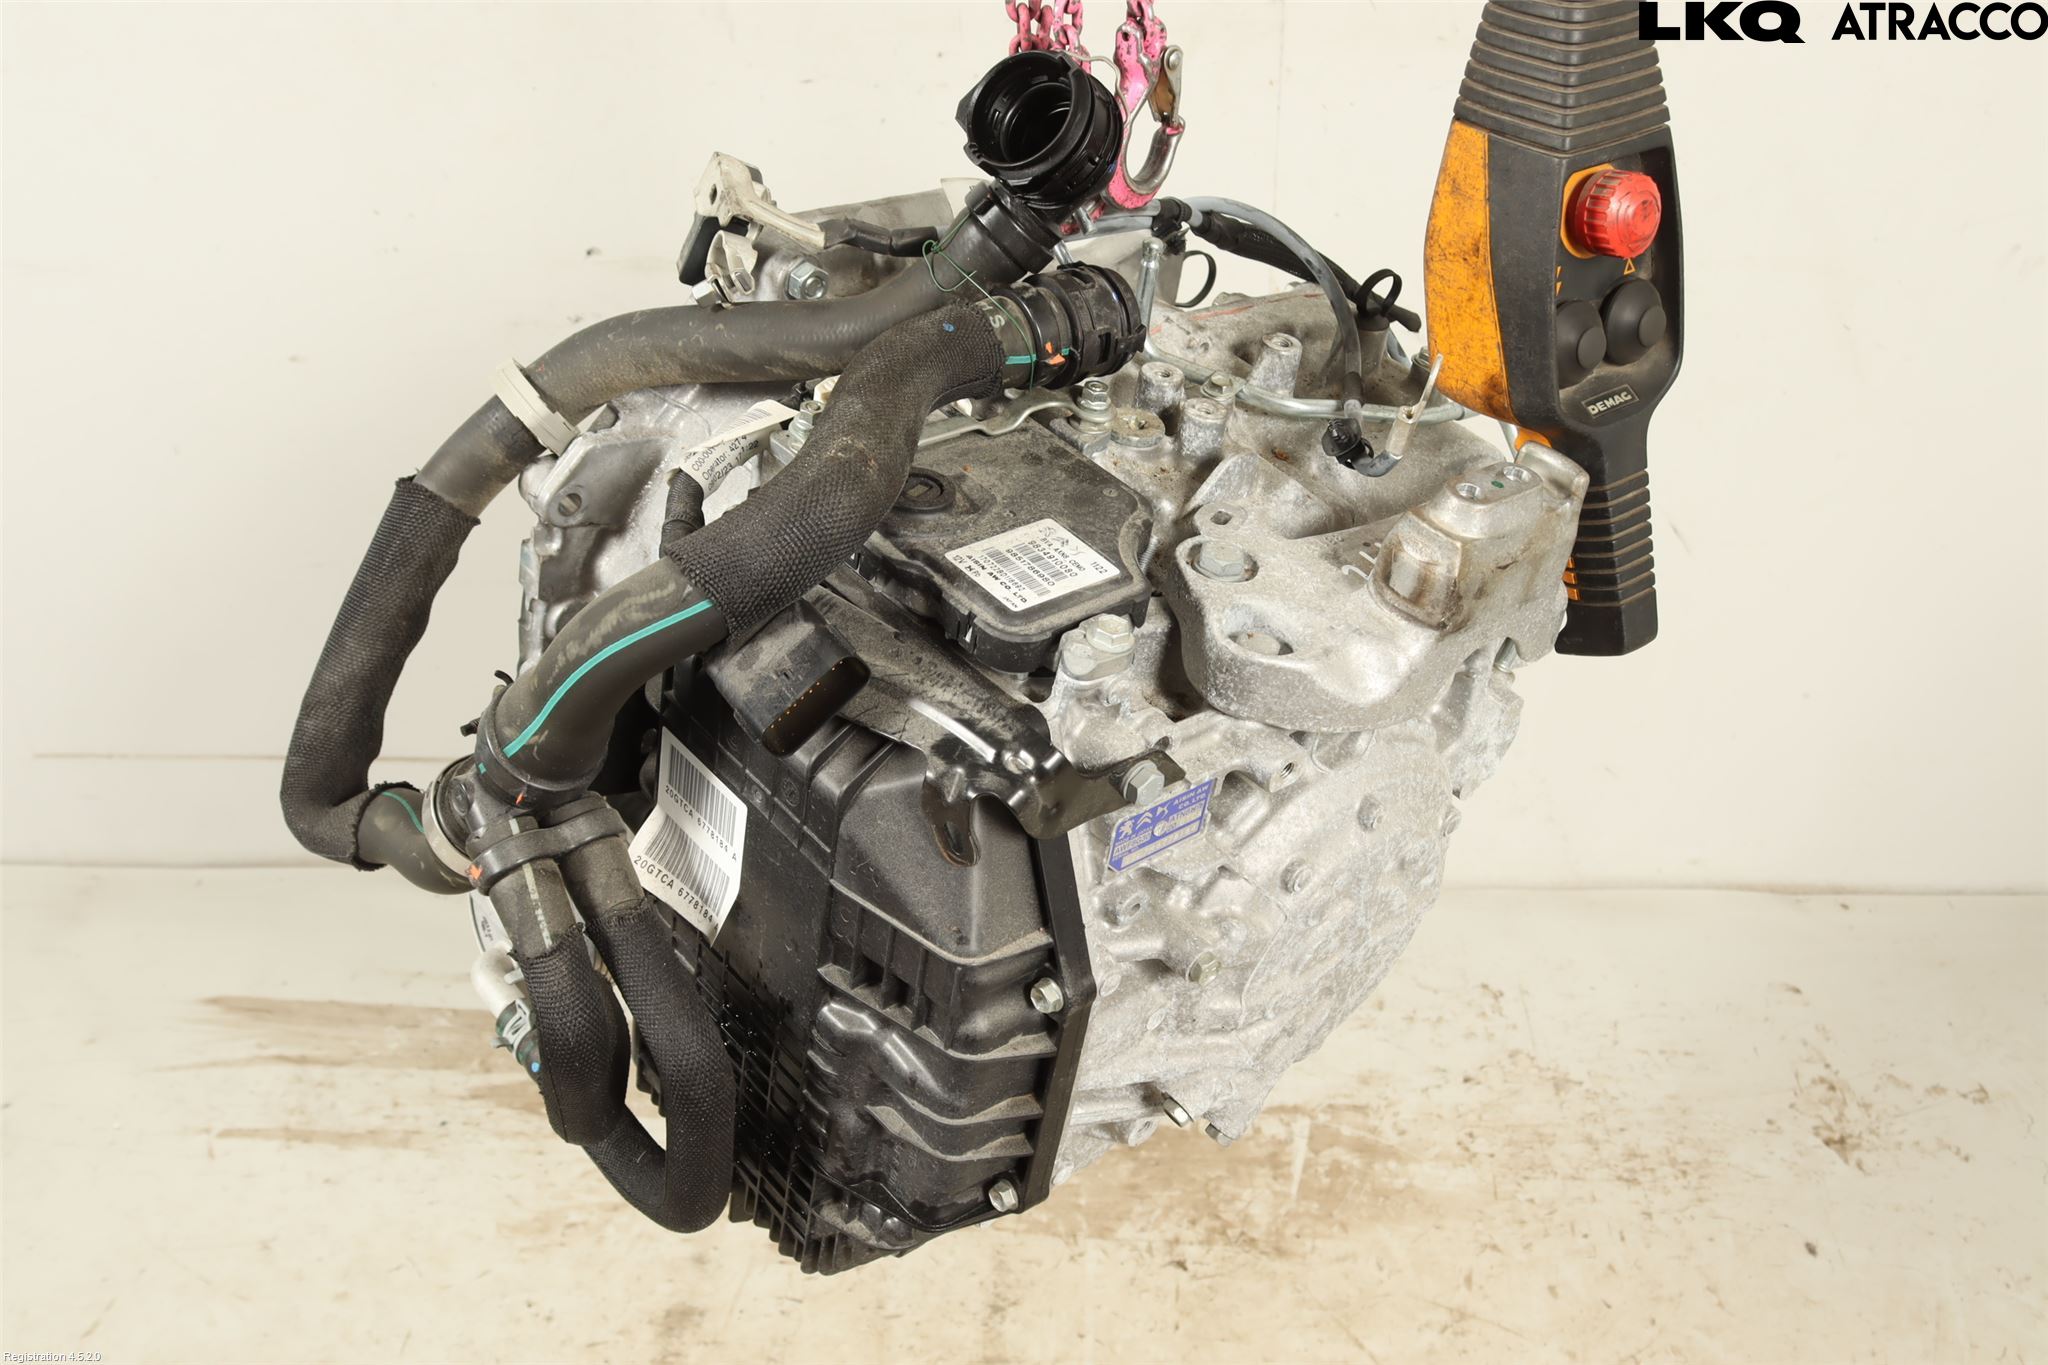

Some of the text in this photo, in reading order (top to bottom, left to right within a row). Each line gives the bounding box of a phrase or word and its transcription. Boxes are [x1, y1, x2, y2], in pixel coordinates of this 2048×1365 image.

[1587, 391, 1632, 415] DEMAC
[966, 554, 987, 570] AISIN
[987, 571, 1000, 581] AW
[1090, 561, 1108, 574] 1122
[665, 785, 693, 818] 20GTCA
[697, 817, 729, 853] 6778184
[633, 855, 674, 890] 20GTCA
[677, 887, 713, 923] 6778184
